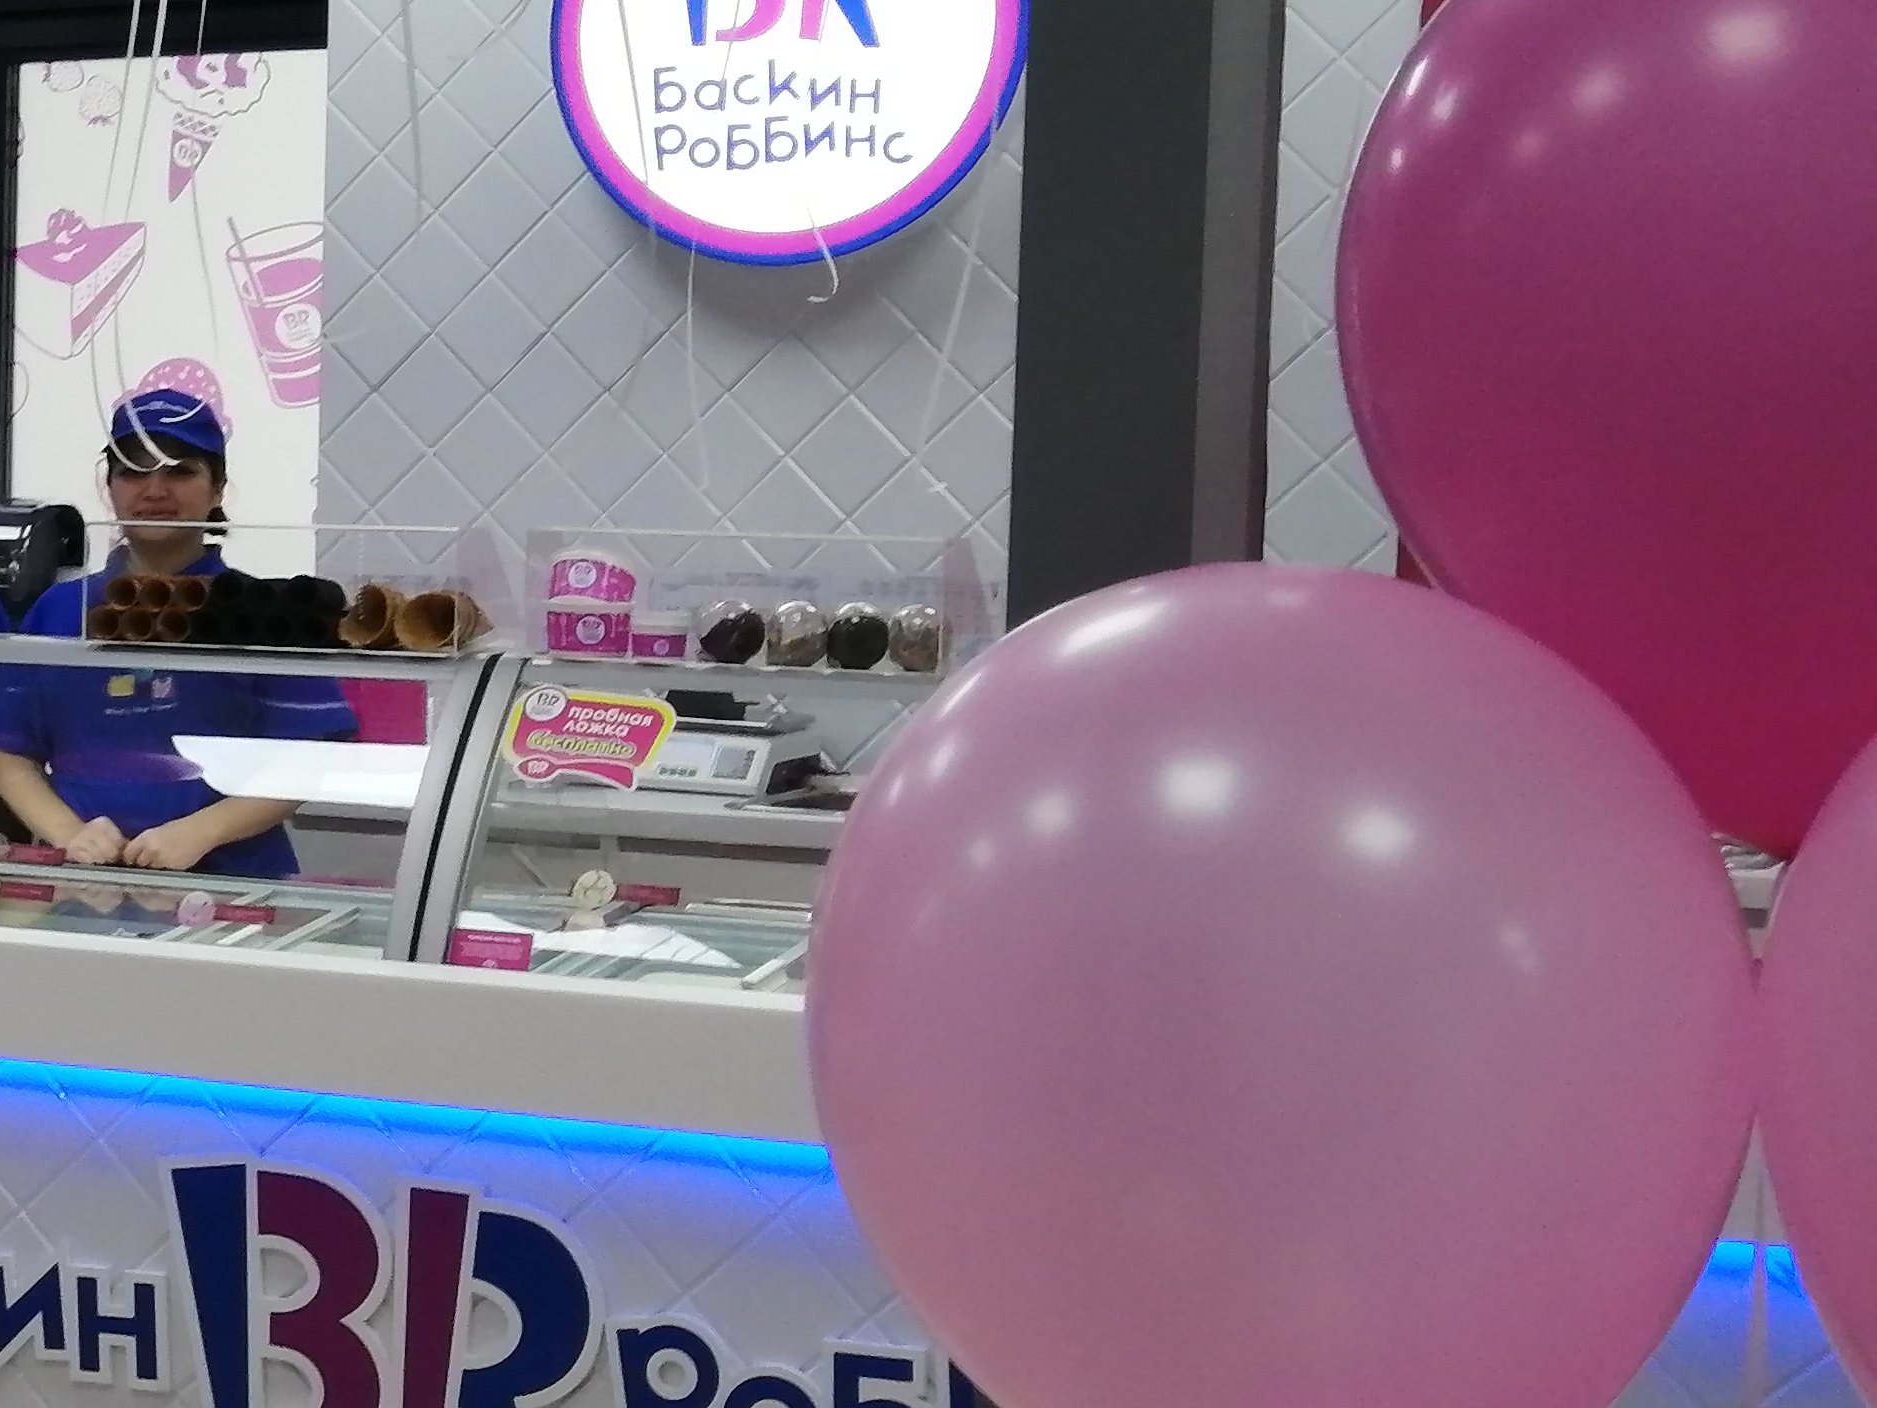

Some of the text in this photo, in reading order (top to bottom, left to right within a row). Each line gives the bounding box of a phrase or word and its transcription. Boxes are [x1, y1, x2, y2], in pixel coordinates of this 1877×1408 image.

[653, 57, 882, 115] Баскин
[567, 705, 654, 728] пробная
[562, 719, 631, 738] ложка
